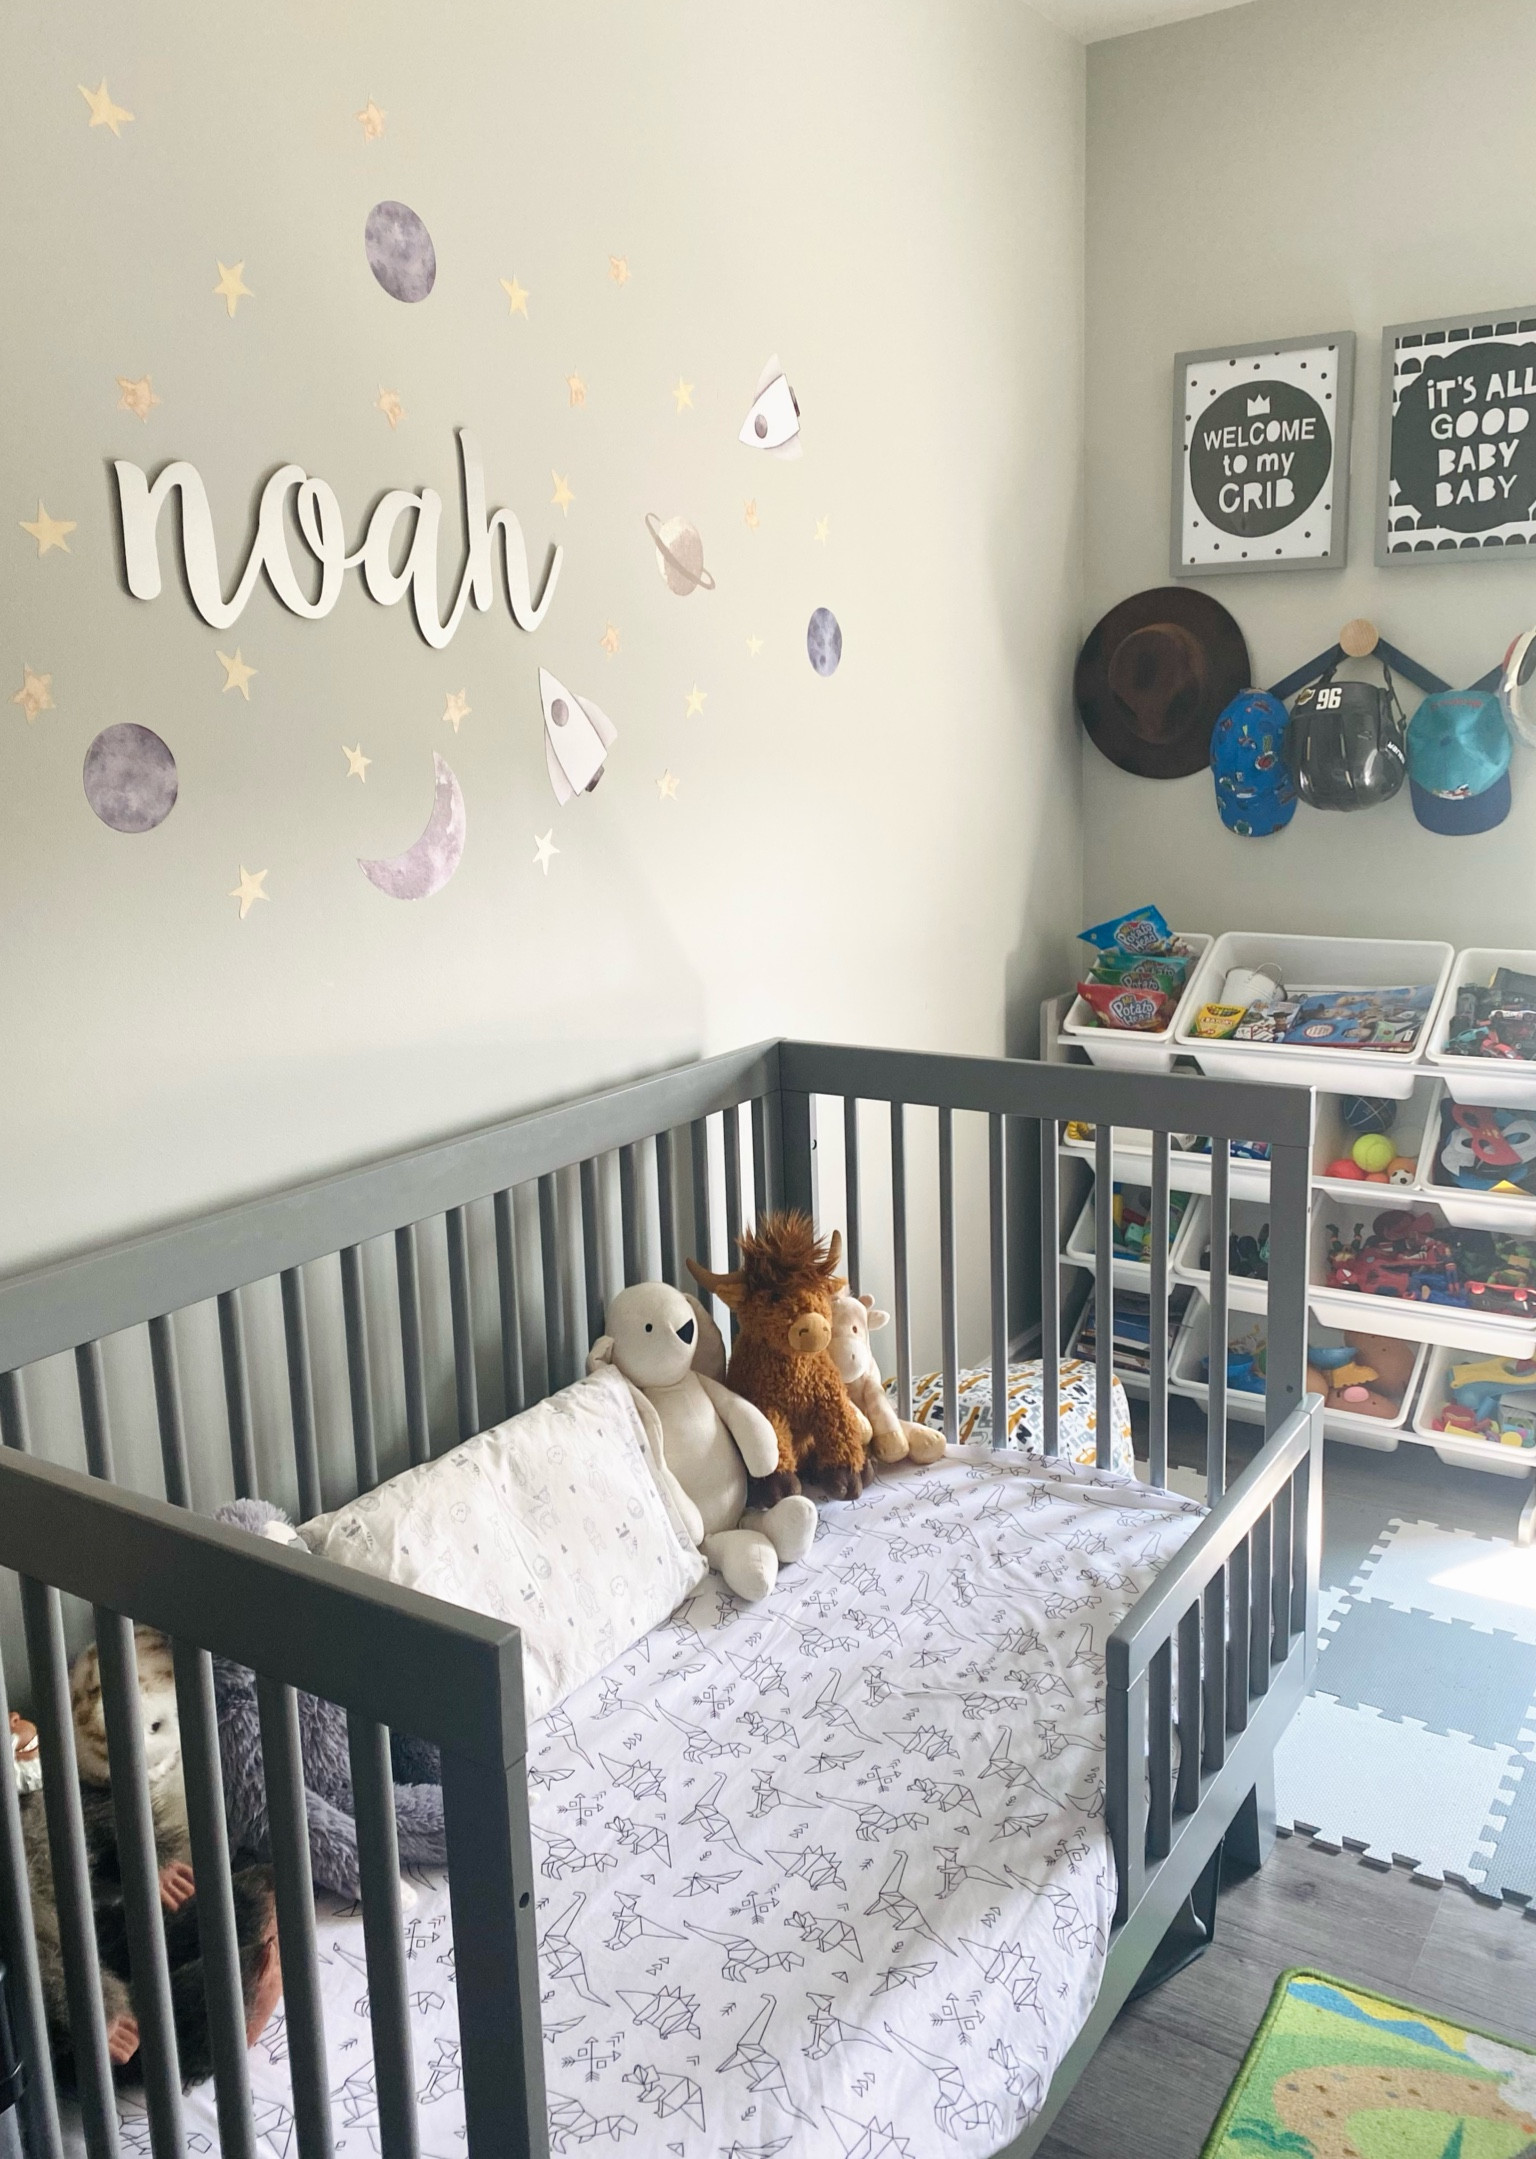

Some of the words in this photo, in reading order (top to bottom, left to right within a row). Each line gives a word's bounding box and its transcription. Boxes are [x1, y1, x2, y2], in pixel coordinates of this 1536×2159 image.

[1485, 367, 1536, 401] ALL
[1203, 418, 1316, 451] WELCOME
[1431, 407, 1529, 440] GOOD
[1223, 454, 1248, 476] to
[1256, 452, 1295, 477] my
[1438, 438, 1519, 477] BABY
[1219, 478, 1295, 513] CRIB
[1436, 474, 1518, 507] BABY
[113, 427, 563, 650] noah
[1316, 687, 1342, 710] 96
[1117, 923, 1154, 946] Potato
[1135, 964, 1175, 977] Ptato
[1113, 1000, 1153, 1018] Potato
